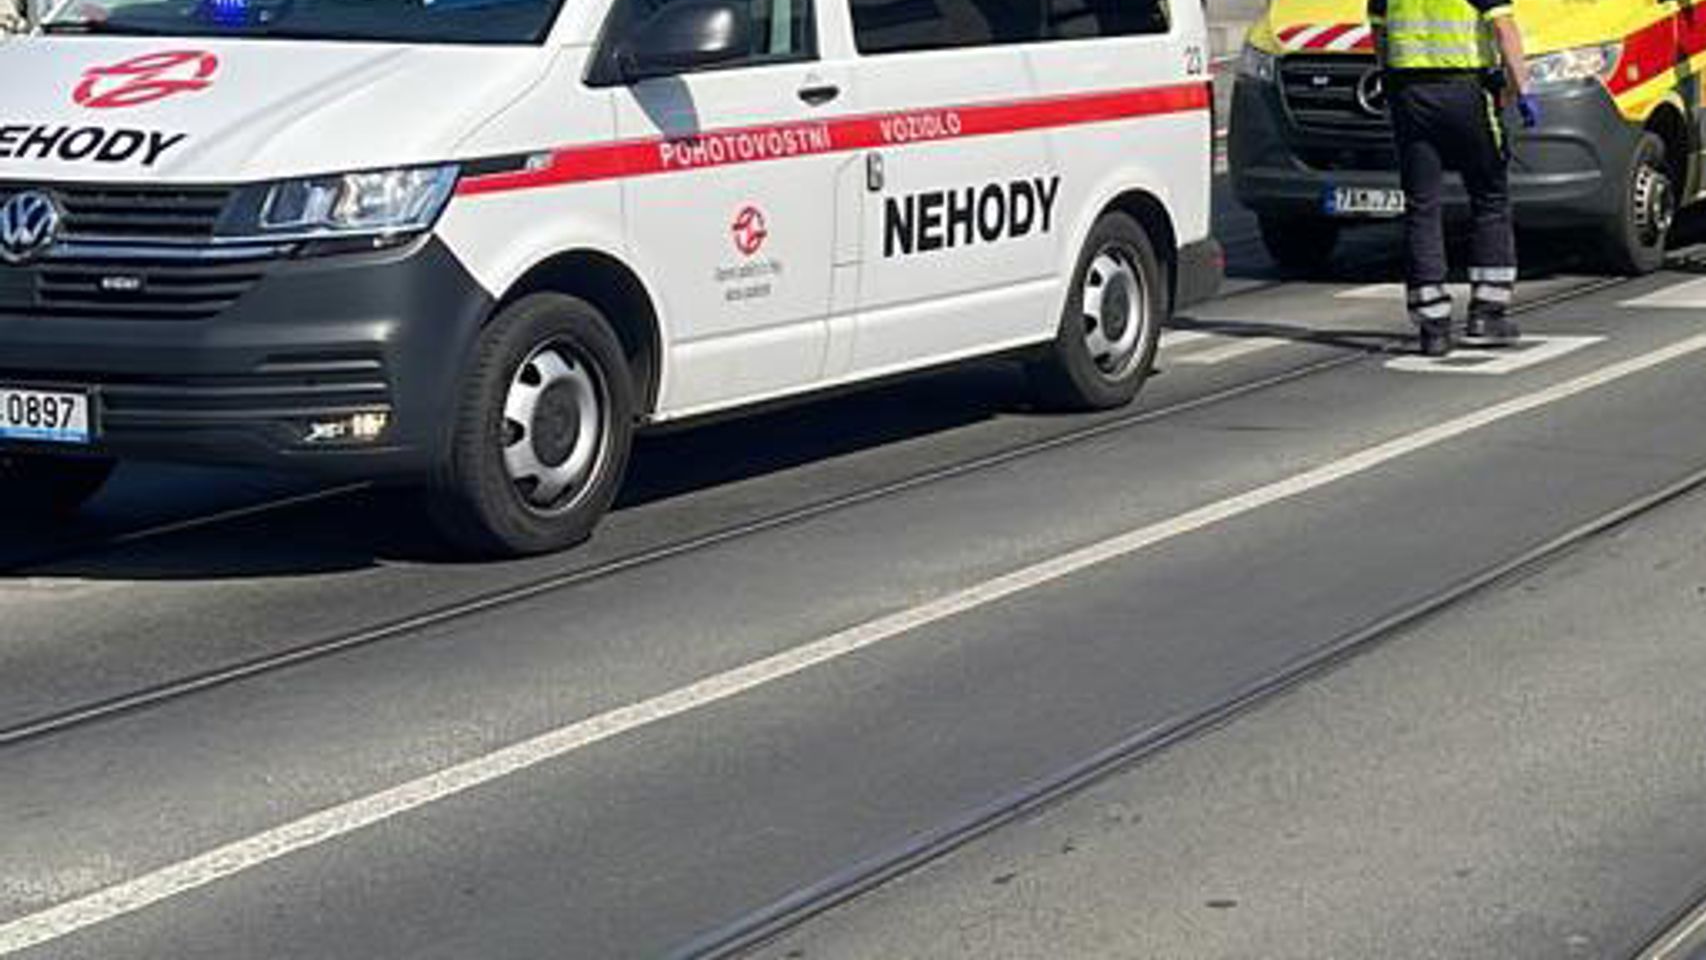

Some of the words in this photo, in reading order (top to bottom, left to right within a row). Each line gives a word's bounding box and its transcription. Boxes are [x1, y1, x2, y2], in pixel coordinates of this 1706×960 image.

[879, 111, 962, 143] VOZIDLO
[883, 175, 1061, 259] NEHODY
[6, 393, 75, 428] 0897
